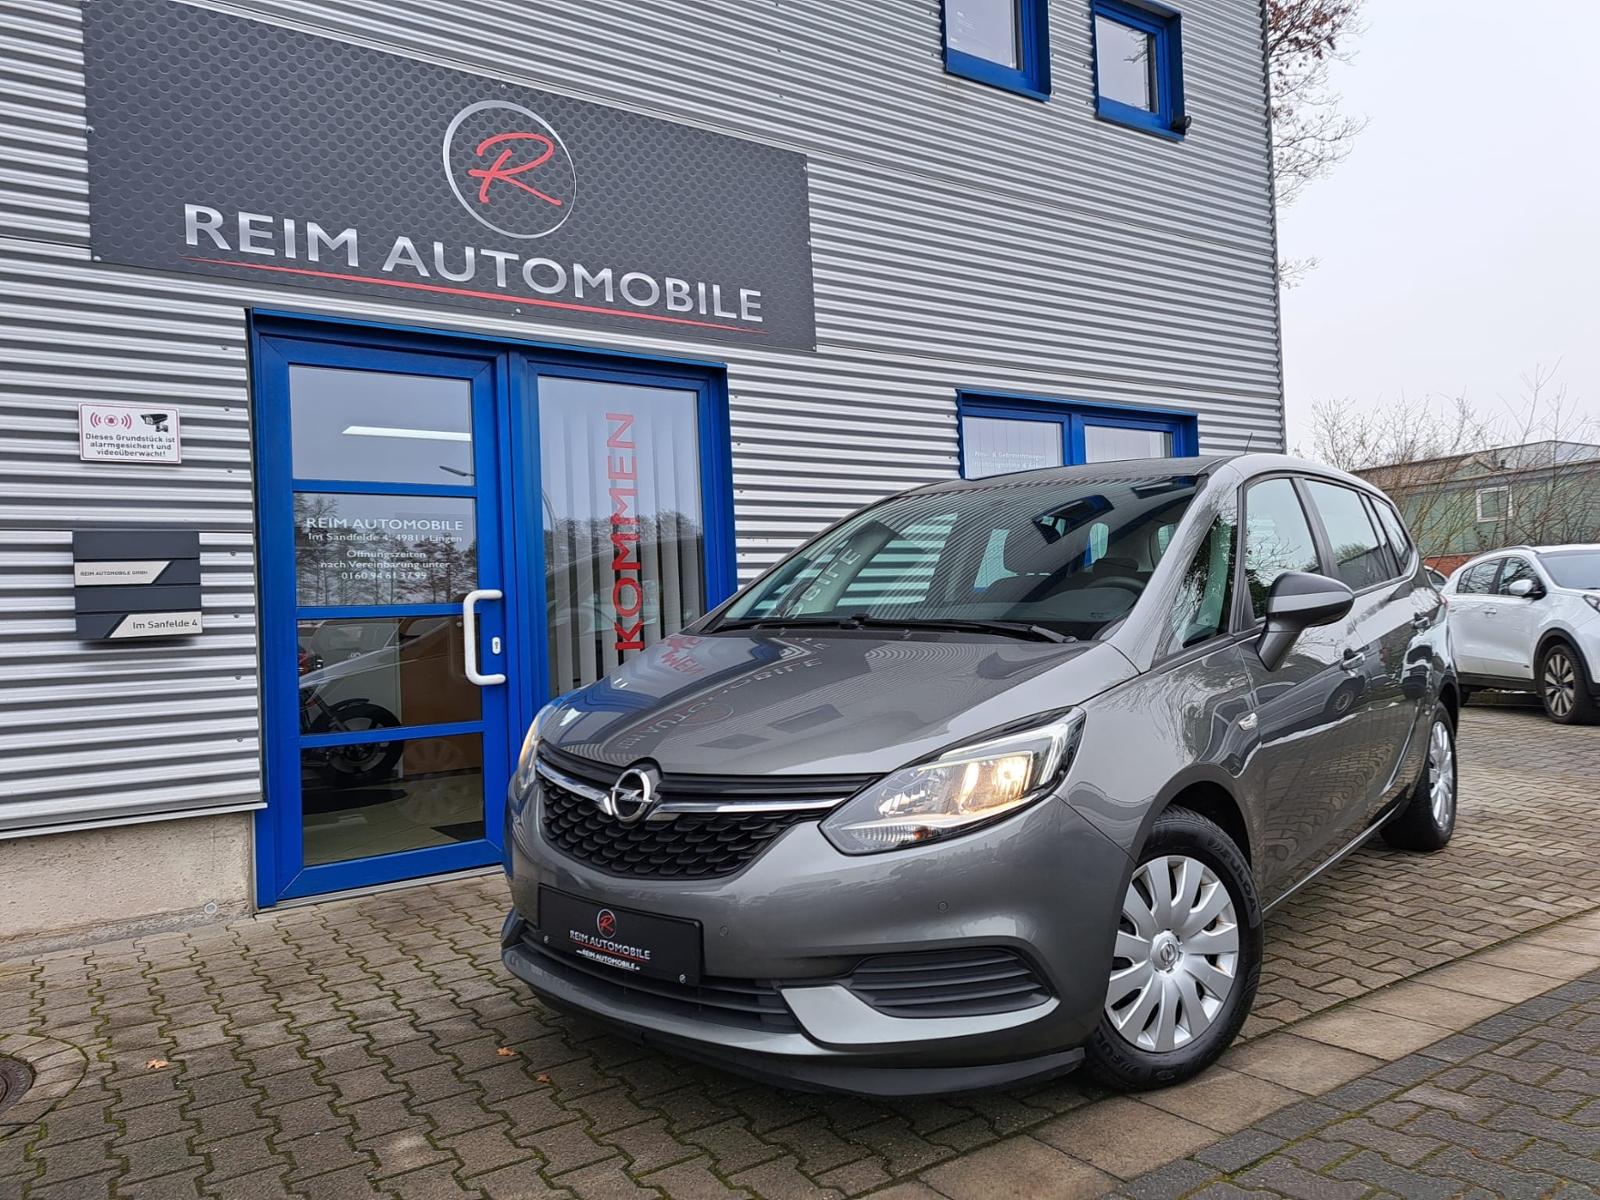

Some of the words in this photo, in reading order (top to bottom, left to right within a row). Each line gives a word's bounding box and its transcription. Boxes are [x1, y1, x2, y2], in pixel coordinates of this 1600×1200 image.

[184, 203, 359, 267] REIM
[382, 236, 764, 322] AUTOMOBILE
[85, 433, 114, 441] Dieses
[116, 434, 163, 443] Grundstück
[90, 441, 154, 450] alarmgesichert
[96, 448, 166, 457] videoüberwacht!
[306, 517, 348, 529] REIM
[352, 518, 465, 531] AUTOMOBILE
[606, 412, 644, 652] KOMMEN
[308, 533, 323, 541] Im
[326, 532, 379, 542] Sandfelde
[429, 534, 463, 545] Lingen
[320, 560, 347, 568] nach
[348, 561, 420, 571] Vereinbarung
[341, 571, 368, 580] 0160
[148, 620, 190, 629] Sanfelde
[569, 930, 589, 944] REIM
[590, 937, 651, 960] AUTOMOBILE
